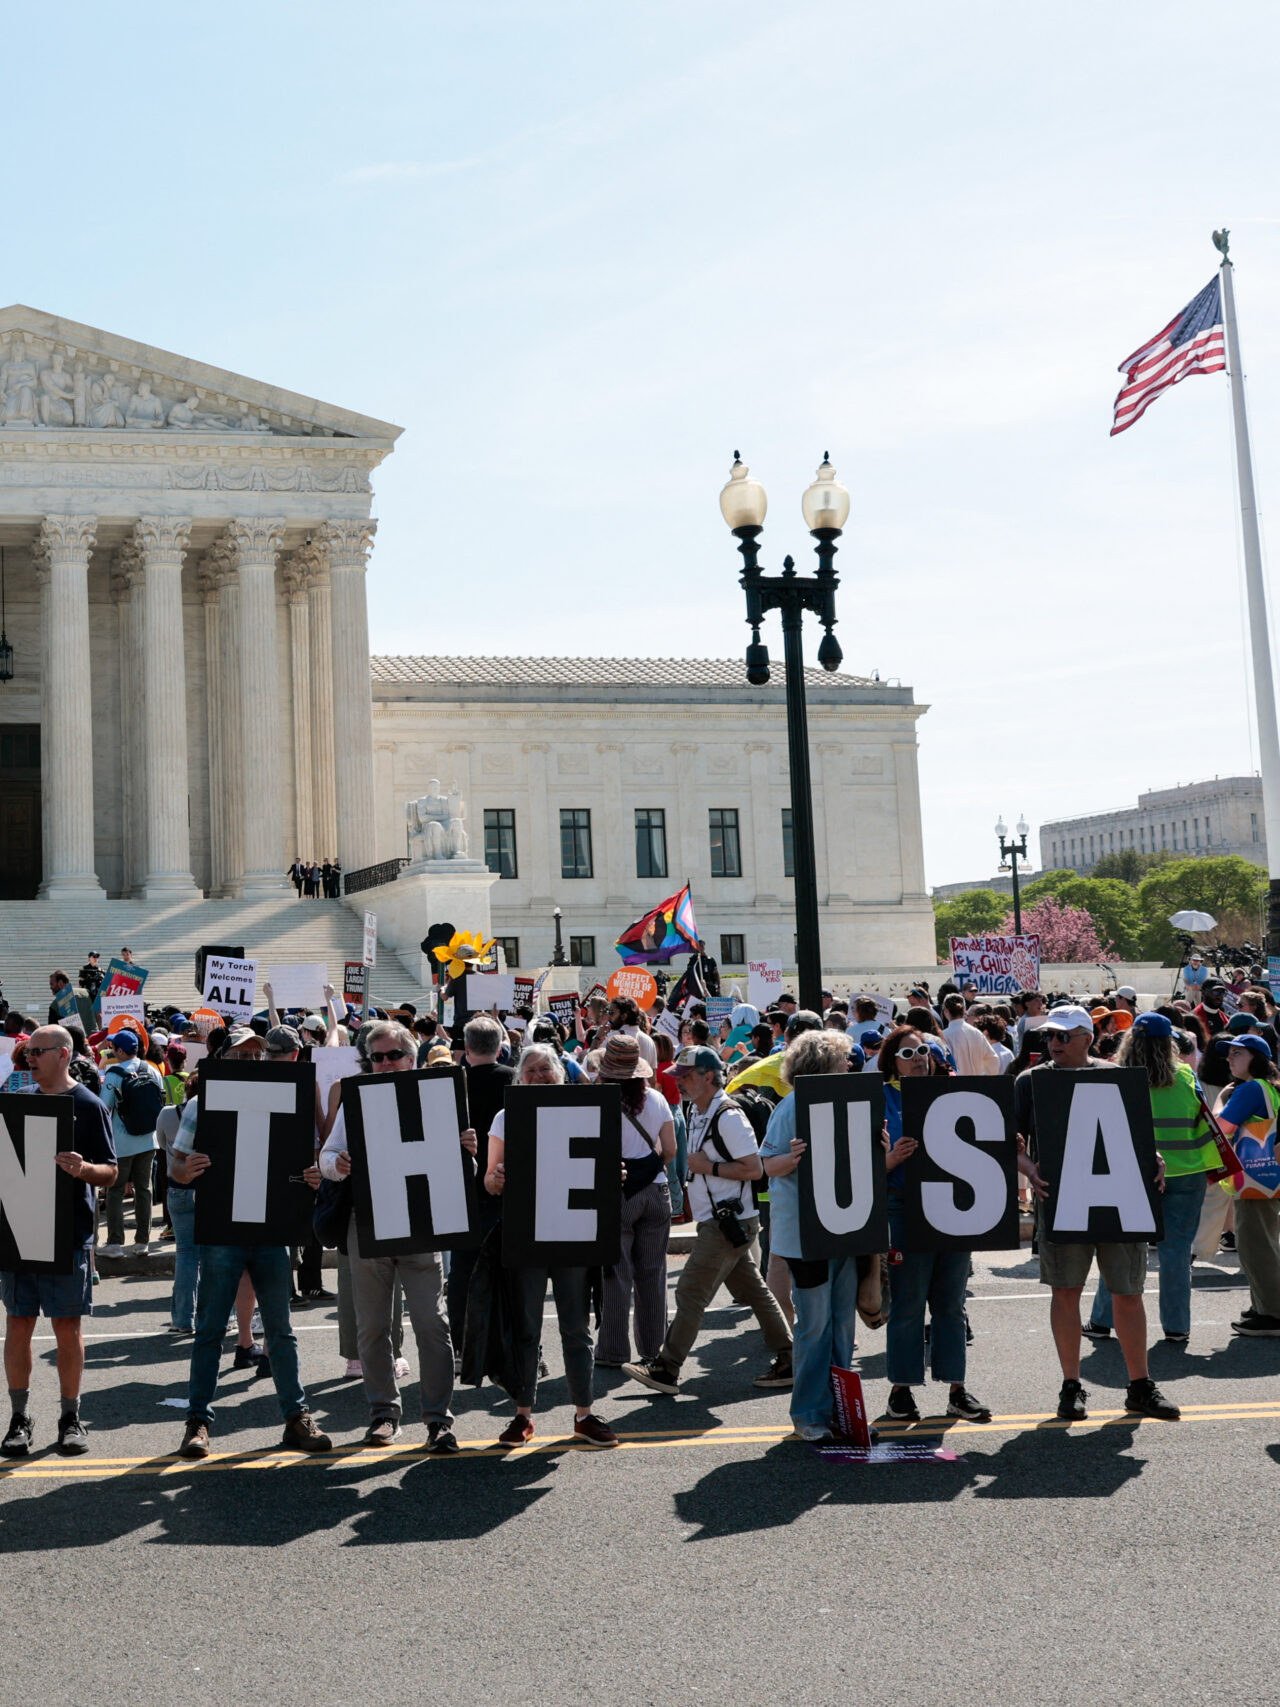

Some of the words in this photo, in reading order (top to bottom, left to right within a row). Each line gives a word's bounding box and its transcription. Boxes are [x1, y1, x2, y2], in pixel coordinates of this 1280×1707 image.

[41, 468, 106, 484] UNDER
[211, 960, 224, 969] My
[228, 962, 254, 971] Torch
[210, 973, 253, 983] Welcomes
[617, 971, 650, 983] RESPECT
[760, 970, 781, 979] RAPED
[613, 978, 640, 990] WOMEN
[642, 983, 652, 992] OF
[207, 985, 251, 1006] ALL
[618, 987, 644, 999] COLOR
